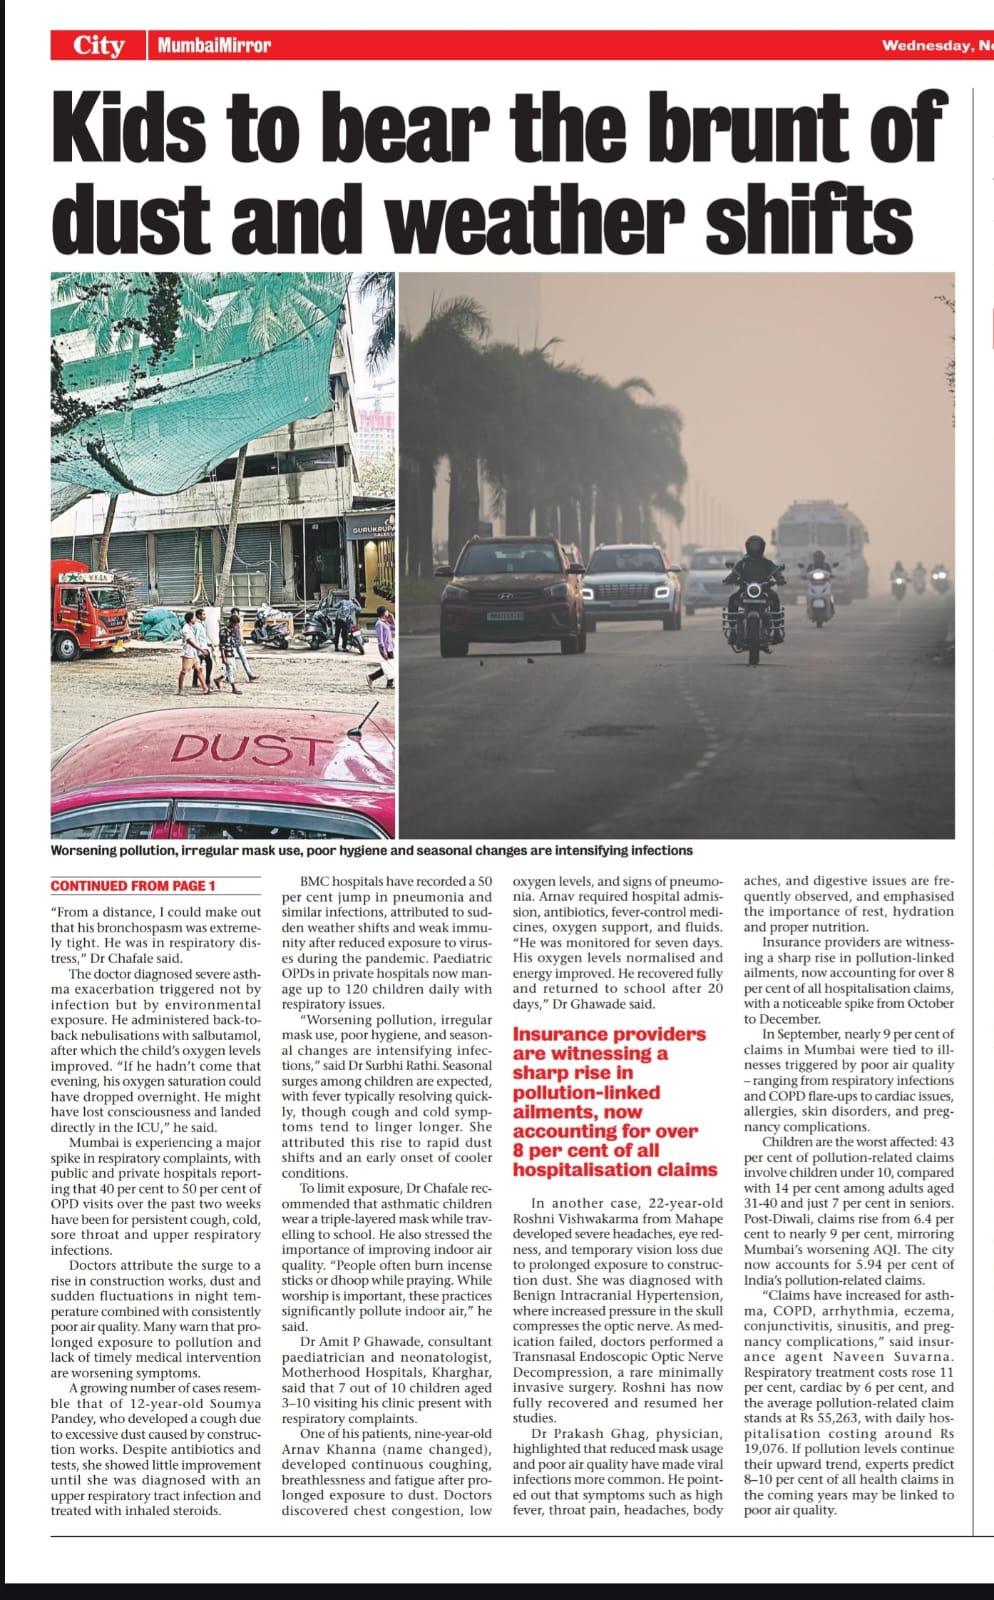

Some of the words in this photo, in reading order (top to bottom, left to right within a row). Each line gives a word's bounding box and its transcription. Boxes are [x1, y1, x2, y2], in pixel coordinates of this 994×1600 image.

[74, 35, 125, 59] City
[158, 37, 271, 53] MumbaiMirror
[883, 40, 974, 53] Wednesday,
[53, 91, 206, 163] Kids
[226, 94, 299, 163] to
[323, 91, 490, 163] bear
[510, 91, 626, 163] the
[650, 91, 849, 163] brunt
[871, 89, 949, 163] of
[53, 183, 211, 255] dust
[232, 183, 362, 255] and
[384, 183, 685, 255] weather
[706, 181, 913, 255] shifts
[170, 733, 334, 767] DUST
[50, 844, 118, 858] Worsening
[119, 844, 179, 858] pollution,
[181, 844, 240, 858] irregular
[241, 844, 276, 856] mask
[278, 847, 304, 857] use,
[306, 847, 337, 858] poor
[339, 844, 388, 858] hygiene
[390, 844, 414, 856] and
[416, 844, 473, 856] seasonal
[475, 844, 528, 858] changes
[530, 847, 553, 856] are
[555, 844, 629, 858] intensifying
[631, 844, 694, 856] infections
[50, 879, 128, 892] CONTINUED
[131, 880, 170, 892] FROM
[172, 880, 206, 892] PAGE
[208, 880, 215, 892] 1
[300, 875, 330, 887] BMC
[332, 875, 384, 890] hospitals
[386, 875, 414, 887] have
[416, 875, 466, 887] recorded
[468, 879, 475, 887] a
[478, 876, 493, 887] 50
[744, 905, 764, 917] the
[769, 906, 840, 920] importance
[844, 905, 858, 917] of
[862, 907, 888, 918] rest,
[893, 905, 954, 920] hydration
[51, 922, 74, 933] that
[77, 921, 95, 933] his
[97, 922, 183, 937] bronchospasm
[185, 924, 208, 933] was
[209, 924, 261, 933] extreme-
[512, 982, 537, 994] and
[543, 983, 598, 994] returned
[605, 984, 618, 994] to
[624, 982, 666, 994] school
[672, 983, 702, 994] after
[708, 983, 724, 994] 20
[282, 999, 346, 1013] respiratory
[348, 999, 385, 1010] issues.
[744, 1015, 757, 1025] to
[759, 1013, 821, 1025] December.
[513, 1026, 609, 1042] Insurance
[613, 1026, 707, 1045] providers
[512, 1048, 546, 1061] are
[550, 1045, 653, 1064] witnessing
[656, 1048, 669, 1061] a
[512, 1064, 570, 1084] sharp
[574, 1064, 612, 1080] rise
[616, 1064, 634, 1080] in
[512, 1084, 661, 1104] pollution-linked
[743, 1090, 766, 1102] and
[768, 1090, 806, 1102] COPD
[808, 1090, 858, 1105] flare-ups
[860, 1092, 873, 1102] to
[874, 1090, 916, 1102] cardiac
[918, 1091, 954, 1104] issues,
[51, 1106, 80, 1117] have
[82, 1106, 104, 1117] lost
[107, 1109, 191, 1117] consciousness
[194, 1106, 217, 1117] and
[220, 1106, 261, 1117] landed
[512, 1103, 599, 1122] ailments,
[603, 1107, 644, 1120] now
[512, 1123, 618, 1142] accounting
[621, 1122, 651, 1139] for
[655, 1126, 699, 1139] over
[512, 1142, 524, 1158] 8
[528, 1145, 563, 1161] per
[567, 1143, 609, 1158] cent
[613, 1142, 634, 1158] of
[636, 1142, 660, 1158] all
[512, 1161, 652, 1180] hospitalisation
[656, 1161, 718, 1177] claims
[513, 1213, 555, 1224] Roshni
[558, 1213, 639, 1224] Vishwakarma
[642, 1213, 671, 1224] from
[675, 1213, 724, 1228] Mahape
[743, 1229, 769, 1239] cent
[773, 1229, 786, 1239] to
[789, 1228, 827, 1242] nearly
[830, 1228, 838, 1239] 9
[841, 1231, 861, 1243] per
[863, 1229, 893, 1240] cent,
[897, 1231, 955, 1243] mirroring
[51, 1245, 113, 1256] infections.
[282, 1244, 350, 1259] importance
[353, 1244, 365, 1255] of
[368, 1244, 431, 1258] improving
[434, 1244, 474, 1255] indoor
[476, 1244, 493, 1255] air
[513, 1289, 556, 1303] Benign
[561, 1289, 632, 1301] Intracranial
[637, 1289, 723, 1304] Hypertension,
[743, 1353, 776, 1362] ance
[784, 1352, 823, 1365] agent
[833, 1351, 884, 1362] Naveen
[894, 1351, 954, 1362] Suvarna.
[281, 1382, 306, 1393] said
[310, 1382, 334, 1393] that
[339, 1382, 346, 1393] 7
[349, 1383, 370, 1393] out
[374, 1382, 388, 1393] of
[392, 1382, 406, 1393] 10
[409, 1382, 460, 1394] children
[464, 1382, 492, 1397] aged
[50, 1398, 70, 1409] ble
[77, 1398, 103, 1409] that
[109, 1398, 123, 1409] of
[131, 1398, 204, 1412] 12-year-old
[209, 1398, 261, 1412] Soumya
[744, 1412, 782, 1423] stands
[785, 1414, 797, 1423] at
[800, 1412, 814, 1424] Rs
[817, 1412, 861, 1425] 55,263,
[864, 1412, 892, 1424] with
[895, 1412, 926, 1426] daily
[929, 1412, 954, 1423] hos-
[531, 1428, 547, 1439] Dr
[554, 1428, 604, 1439] Prakash
[610, 1428, 649, 1442] Ghag,
[656, 1428, 723, 1443] physician,
[51, 1505, 92, 1516] treated
[94, 1505, 122, 1516] with
[125, 1505, 170, 1516] inhaled
[173, 1505, 222, 1516] steroids.
[281, 1505, 348, 1516] discovered
[353, 1505, 386, 1516] chest
[391, 1505, 464, 1519] congestion,
[470, 1505, 492, 1516] low
[513, 1504, 545, 1516] fever,
[549, 1504, 586, 1516] throat
[589, 1505, 620, 1519] pain,
[624, 1504, 689, 1517] headaches,
[693, 1504, 724, 1518] body
[744, 1507, 772, 1519] poor
[774, 1505, 791, 1516] air
[792, 1504, 837, 1519] quality.
